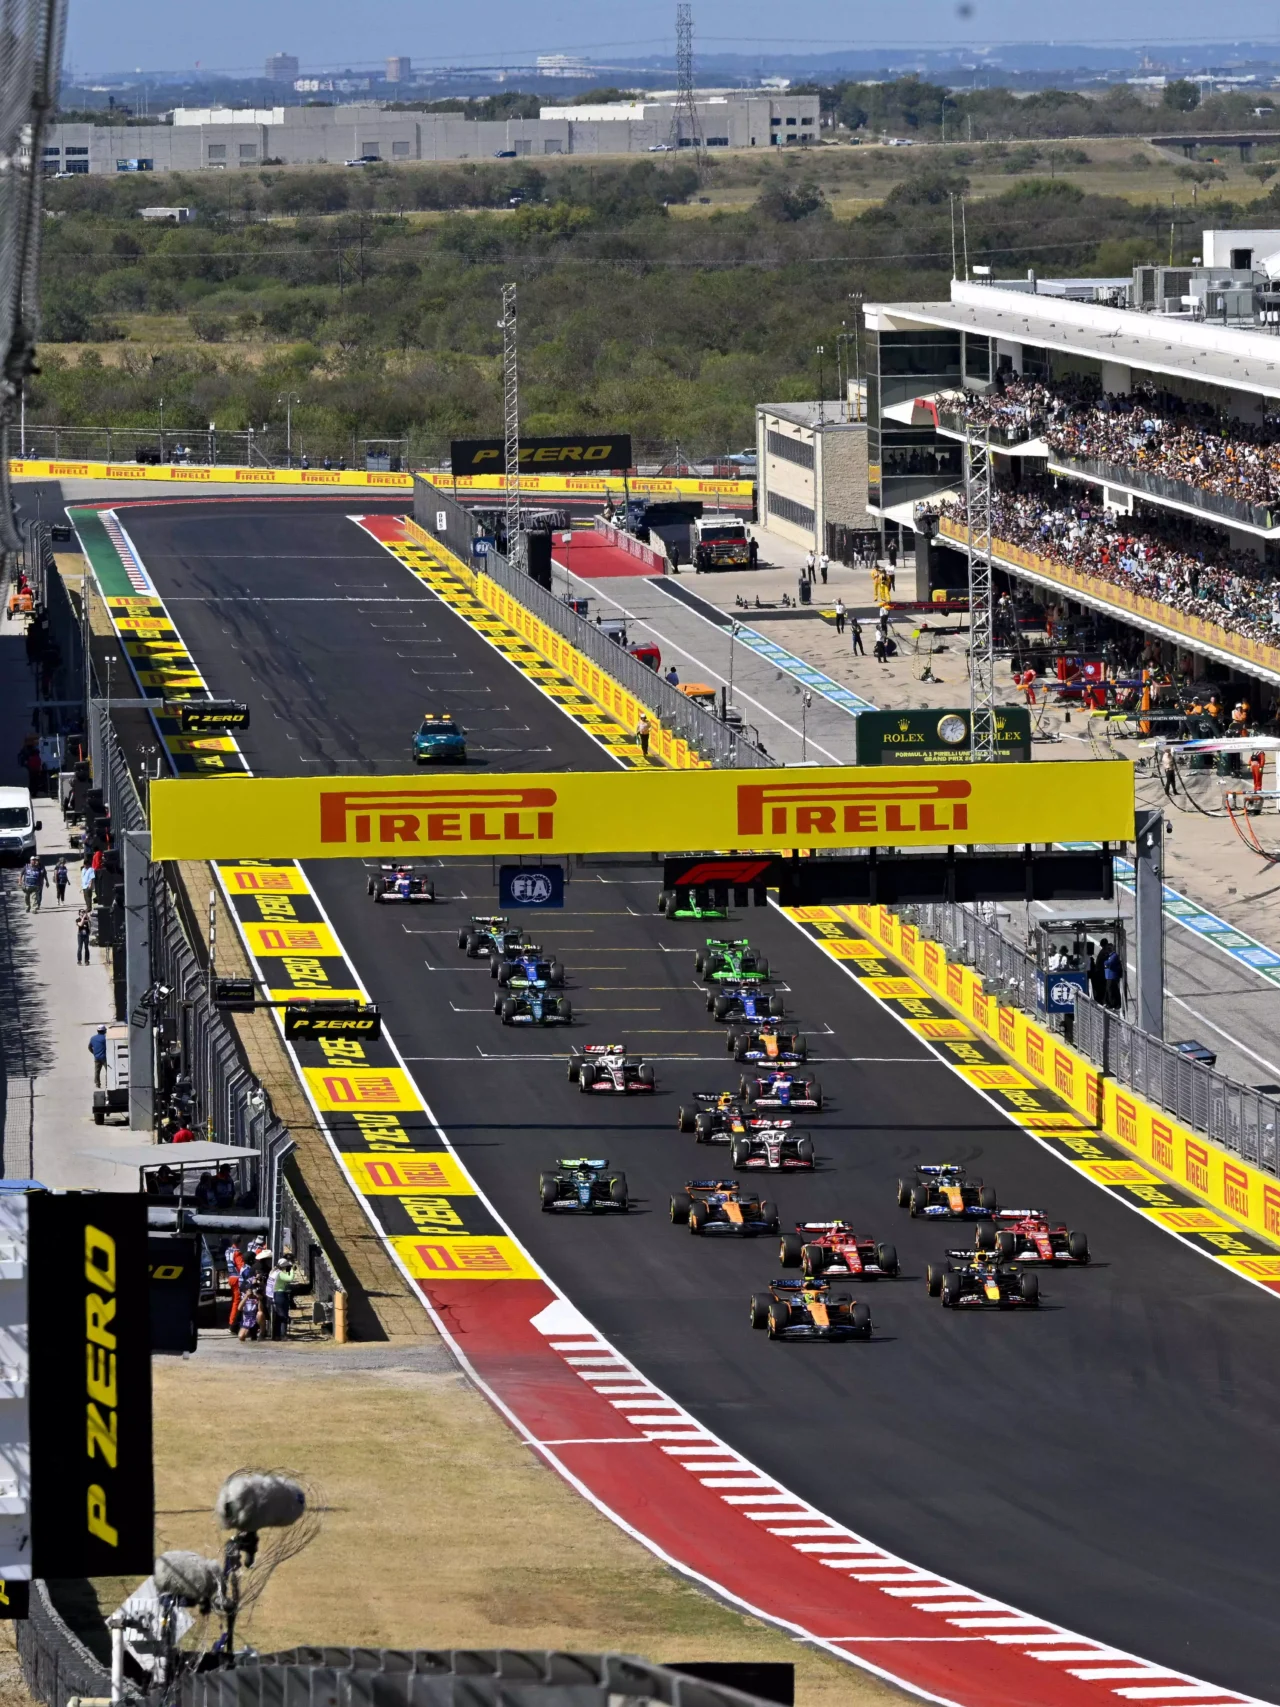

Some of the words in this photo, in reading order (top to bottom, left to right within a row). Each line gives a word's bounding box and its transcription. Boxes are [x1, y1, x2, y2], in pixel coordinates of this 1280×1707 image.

[472, 449, 499, 464] P
[106, 467, 146, 478] PIRELLI
[171, 468, 211, 480] PIRELLI
[235, 470, 276, 482] PIRELLI
[300, 471, 341, 484] PIRELLI
[367, 473, 407, 486] PIRELLI
[565, 478, 606, 490] PIRELLI
[631, 479, 673, 491] PIRELLI
[698, 481, 739, 493] PIRELLI
[883, 733, 925, 743] ROLEX
[320, 787, 557, 843] PIRELLI
[737, 779, 972, 836] PIRELLI
[293, 1020, 309, 1029] P
[312, 1020, 374, 1029] ZERO
[1026, 1026, 1044, 1076] PIRELLI
[1054, 1048, 1073, 1100] PIRELLI
[353, 1113, 410, 1143] ZERO
[1116, 1094, 1137, 1147] PIRELLI
[1151, 1117, 1173, 1171] PIRELLI
[364, 1162, 451, 1187] PIRELLI
[1185, 1139, 1209, 1194] PIRELLI
[1224, 1161, 1249, 1218] PIRELLI
[398, 1197, 464, 1226] ZERO
[414, 1245, 513, 1271] PIRELLI
[85, 1224, 118, 1469] ZERO
[87, 1484, 119, 1548] P
